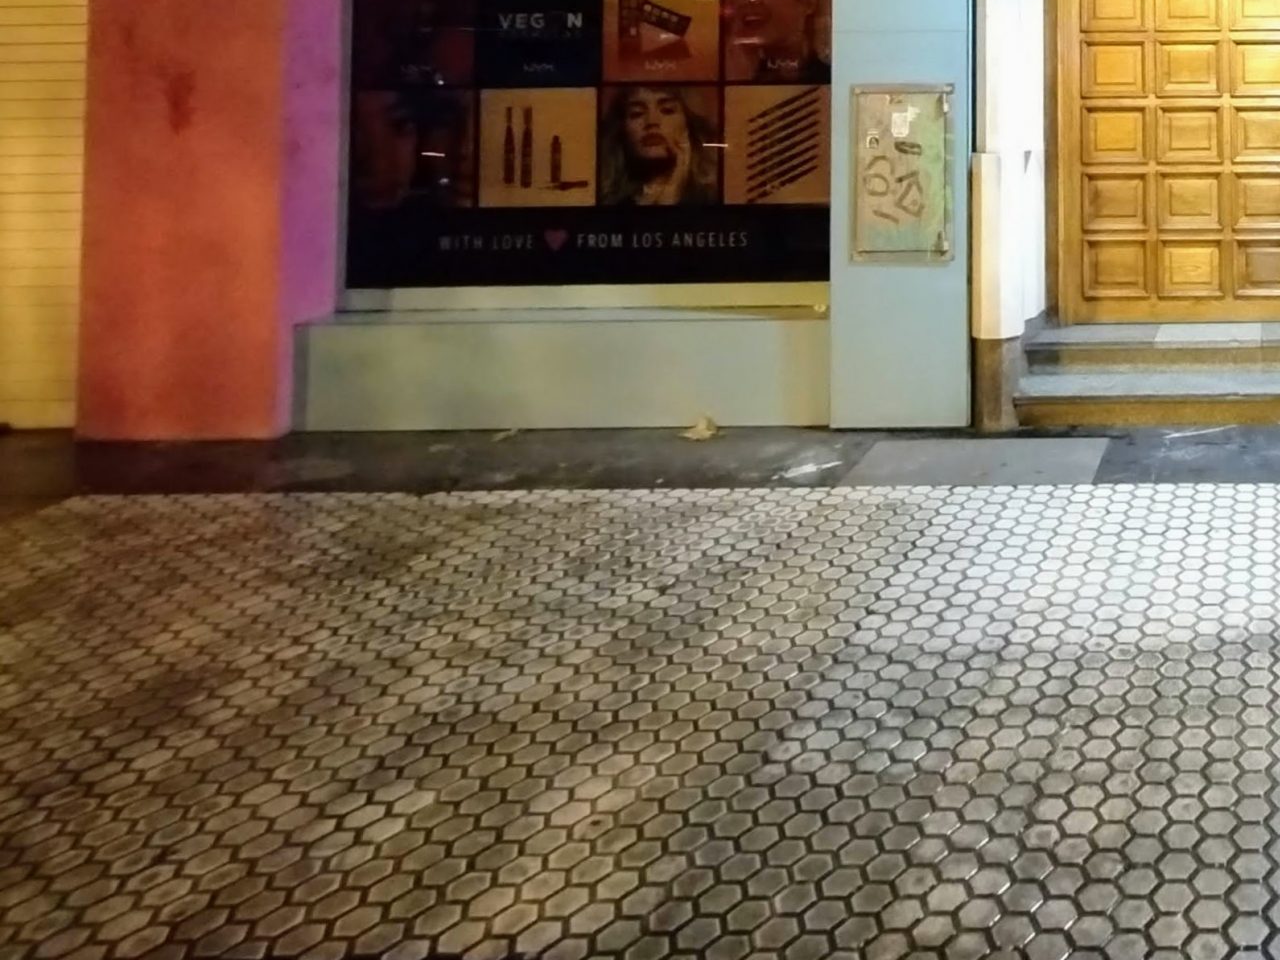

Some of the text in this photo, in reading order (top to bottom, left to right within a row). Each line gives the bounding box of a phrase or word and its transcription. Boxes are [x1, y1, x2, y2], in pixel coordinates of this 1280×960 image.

[498, 12, 583, 29] VEGN
[439, 232, 749, 250] WITH LOVE FROM LOS ANGELES
